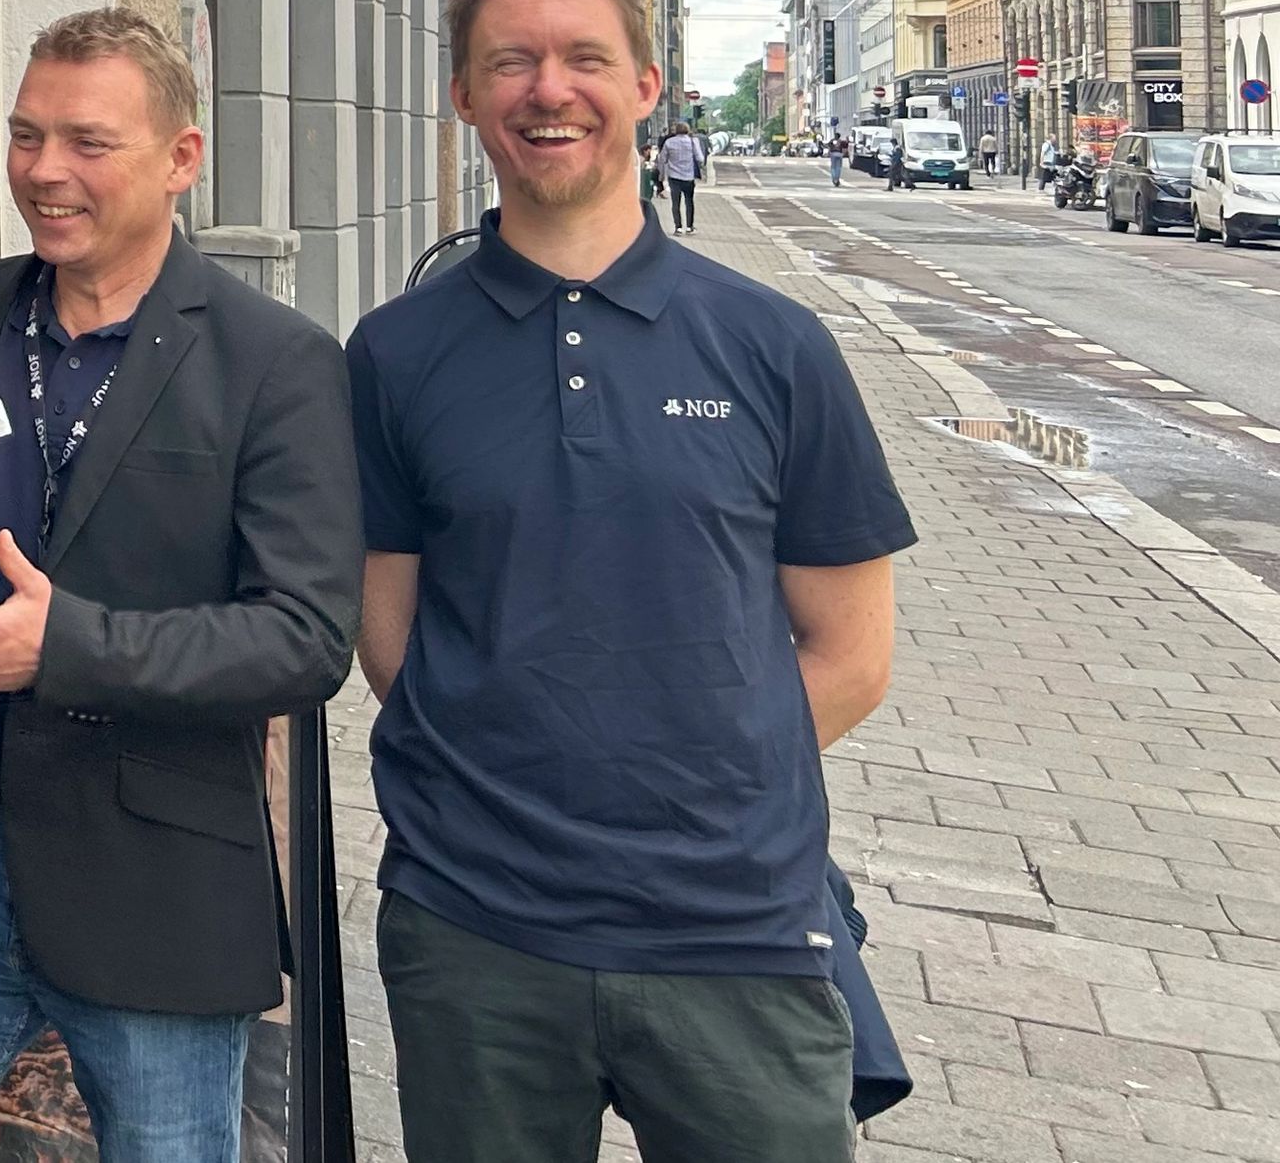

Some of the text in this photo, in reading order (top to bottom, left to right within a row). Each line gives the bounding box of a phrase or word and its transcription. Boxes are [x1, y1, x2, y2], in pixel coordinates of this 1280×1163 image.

[1144, 83, 1176, 93] CITY
[1154, 93, 1182, 103] BOX
[28, 355, 41, 383] NOF
[685, 399, 731, 418] NOF
